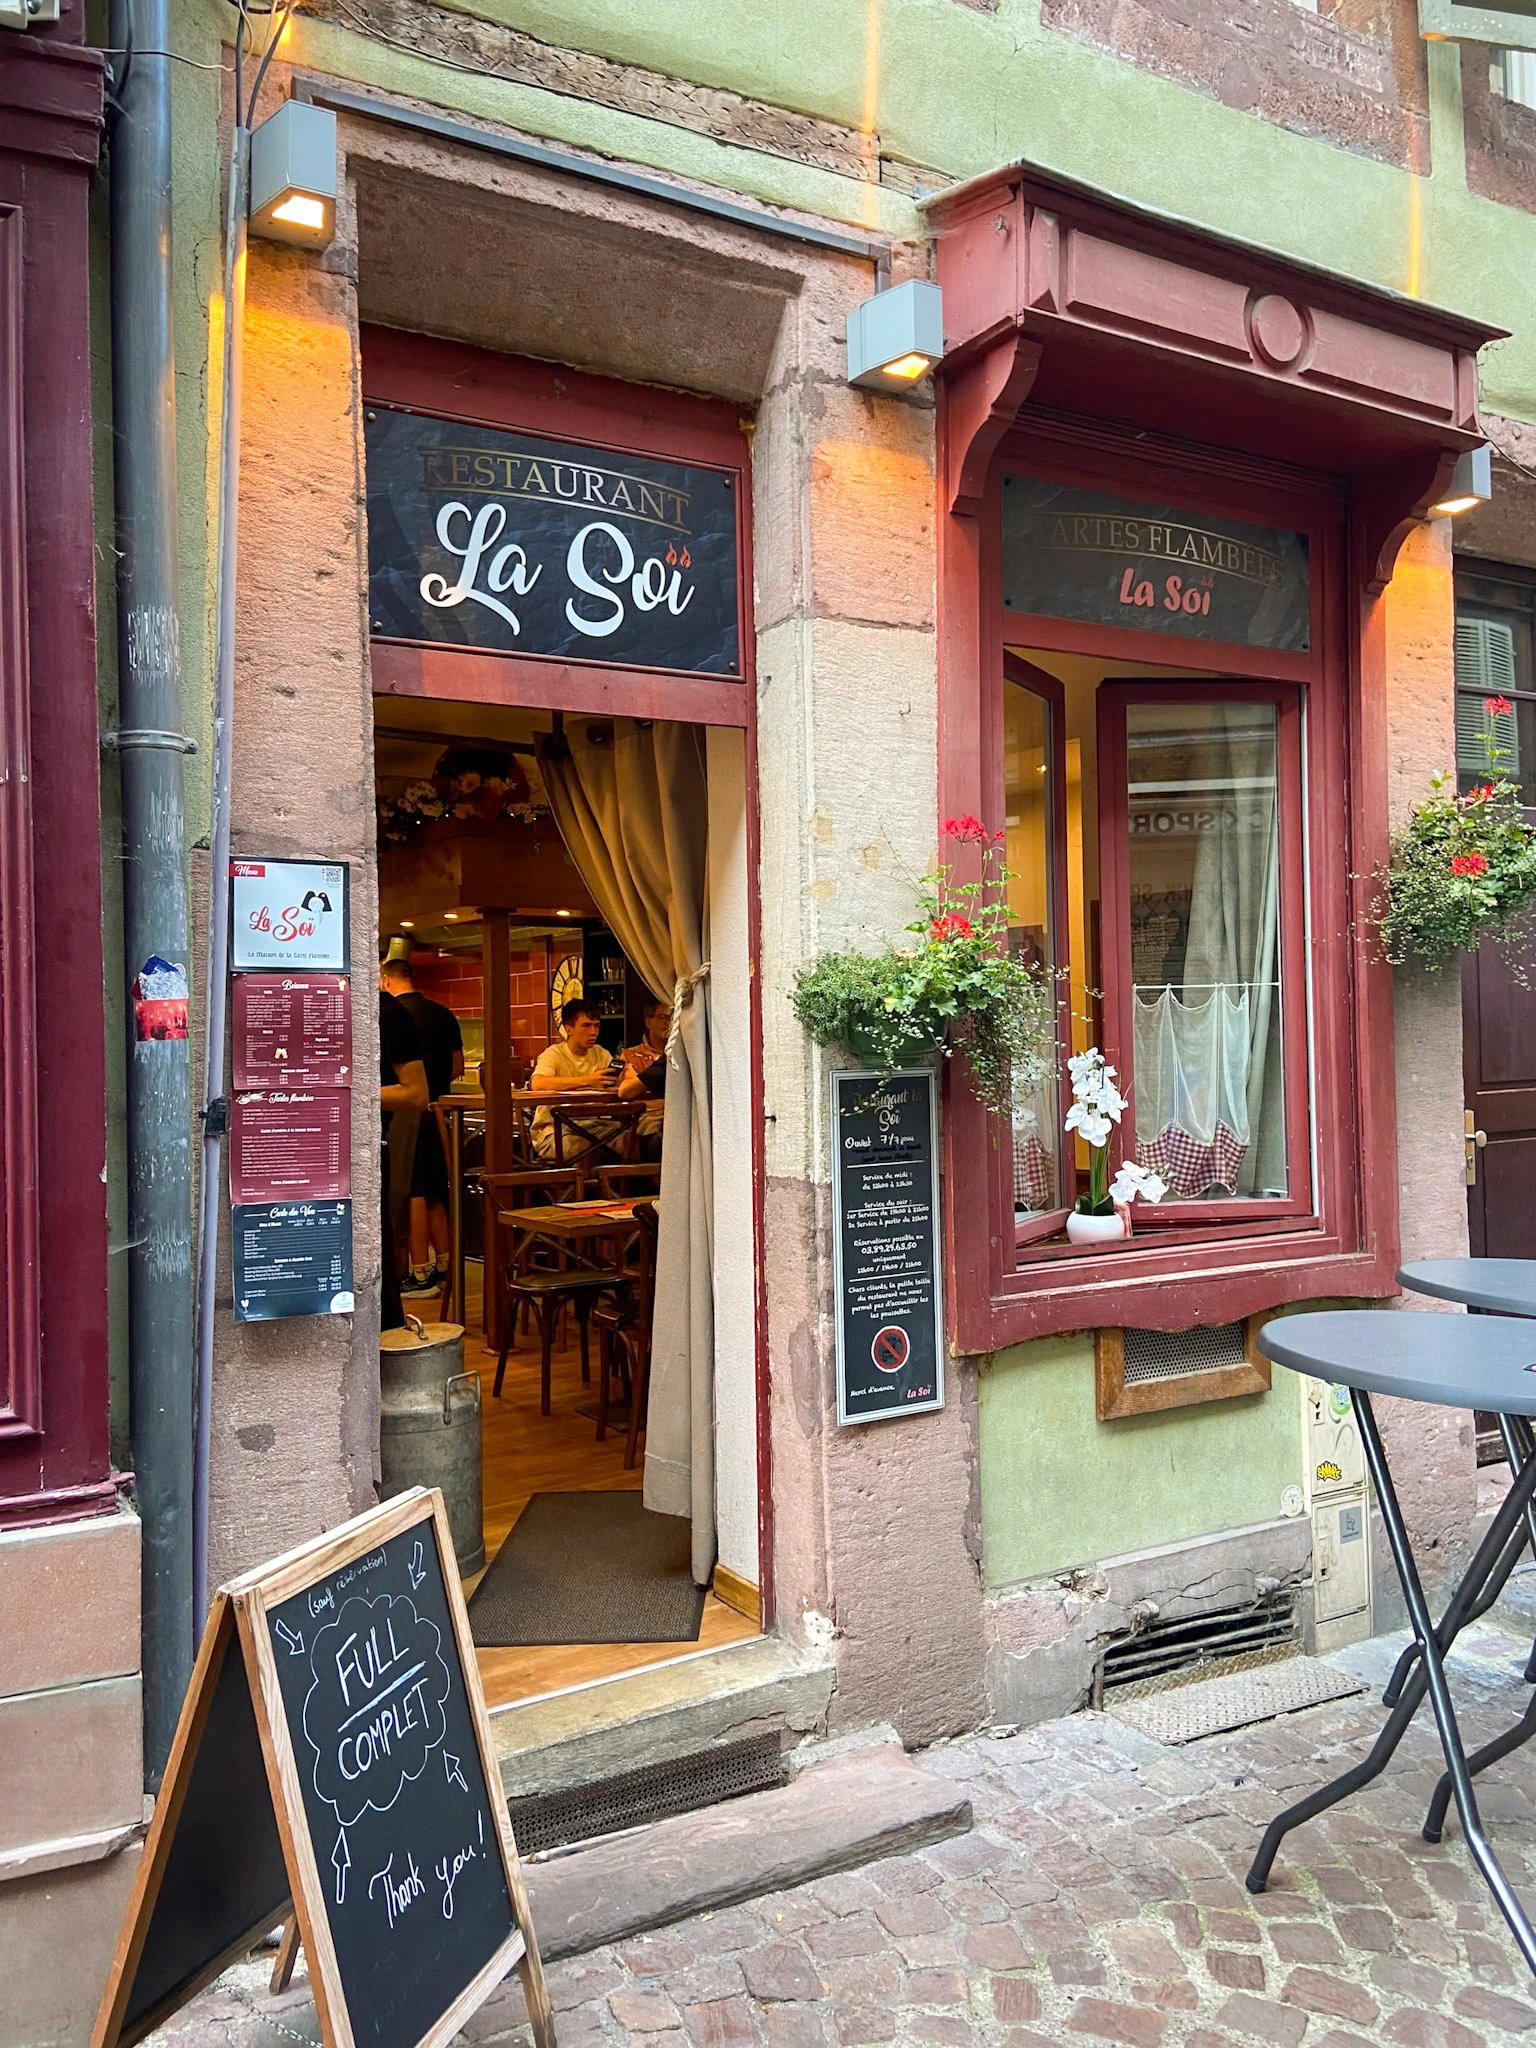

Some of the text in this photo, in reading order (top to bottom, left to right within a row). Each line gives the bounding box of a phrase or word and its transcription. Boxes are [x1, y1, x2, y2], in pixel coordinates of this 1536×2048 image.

[421, 452, 690, 526] RESTAURANT
[1051, 516, 1140, 549] ARTES
[419, 501, 543, 636] La
[1119, 567, 1155, 608] La
[249, 906, 272, 933] La
[844, 1136, 872, 1149] Ouvert
[880, 1133, 899, 1146] 7/7
[862, 1174, 884, 1182] Service
[862, 1183, 871, 1191] de
[864, 1201, 885, 1209] Service
[858, 1211, 879, 1219] Service
[856, 1220, 878, 1228] Service
[884, 1217, 902, 1228] partir
[853, 1238, 891, 1247] Réservations
[860, 1242, 918, 1255] 03.89.29.63.50
[848, 1286, 865, 1294] Chers
[897, 1280, 914, 1290] petite
[857, 1294, 866, 1302] du
[868, 1291, 898, 1300] restaurant
[852, 1304, 873, 1315] permet
[874, 1303, 884, 1312] pas
[906, 1389, 917, 1399] La
[335, 1617, 411, 1707] FULL
[337, 1677, 430, 1781] COMPLET
[368, 1810, 488, 1930] Thank you!
